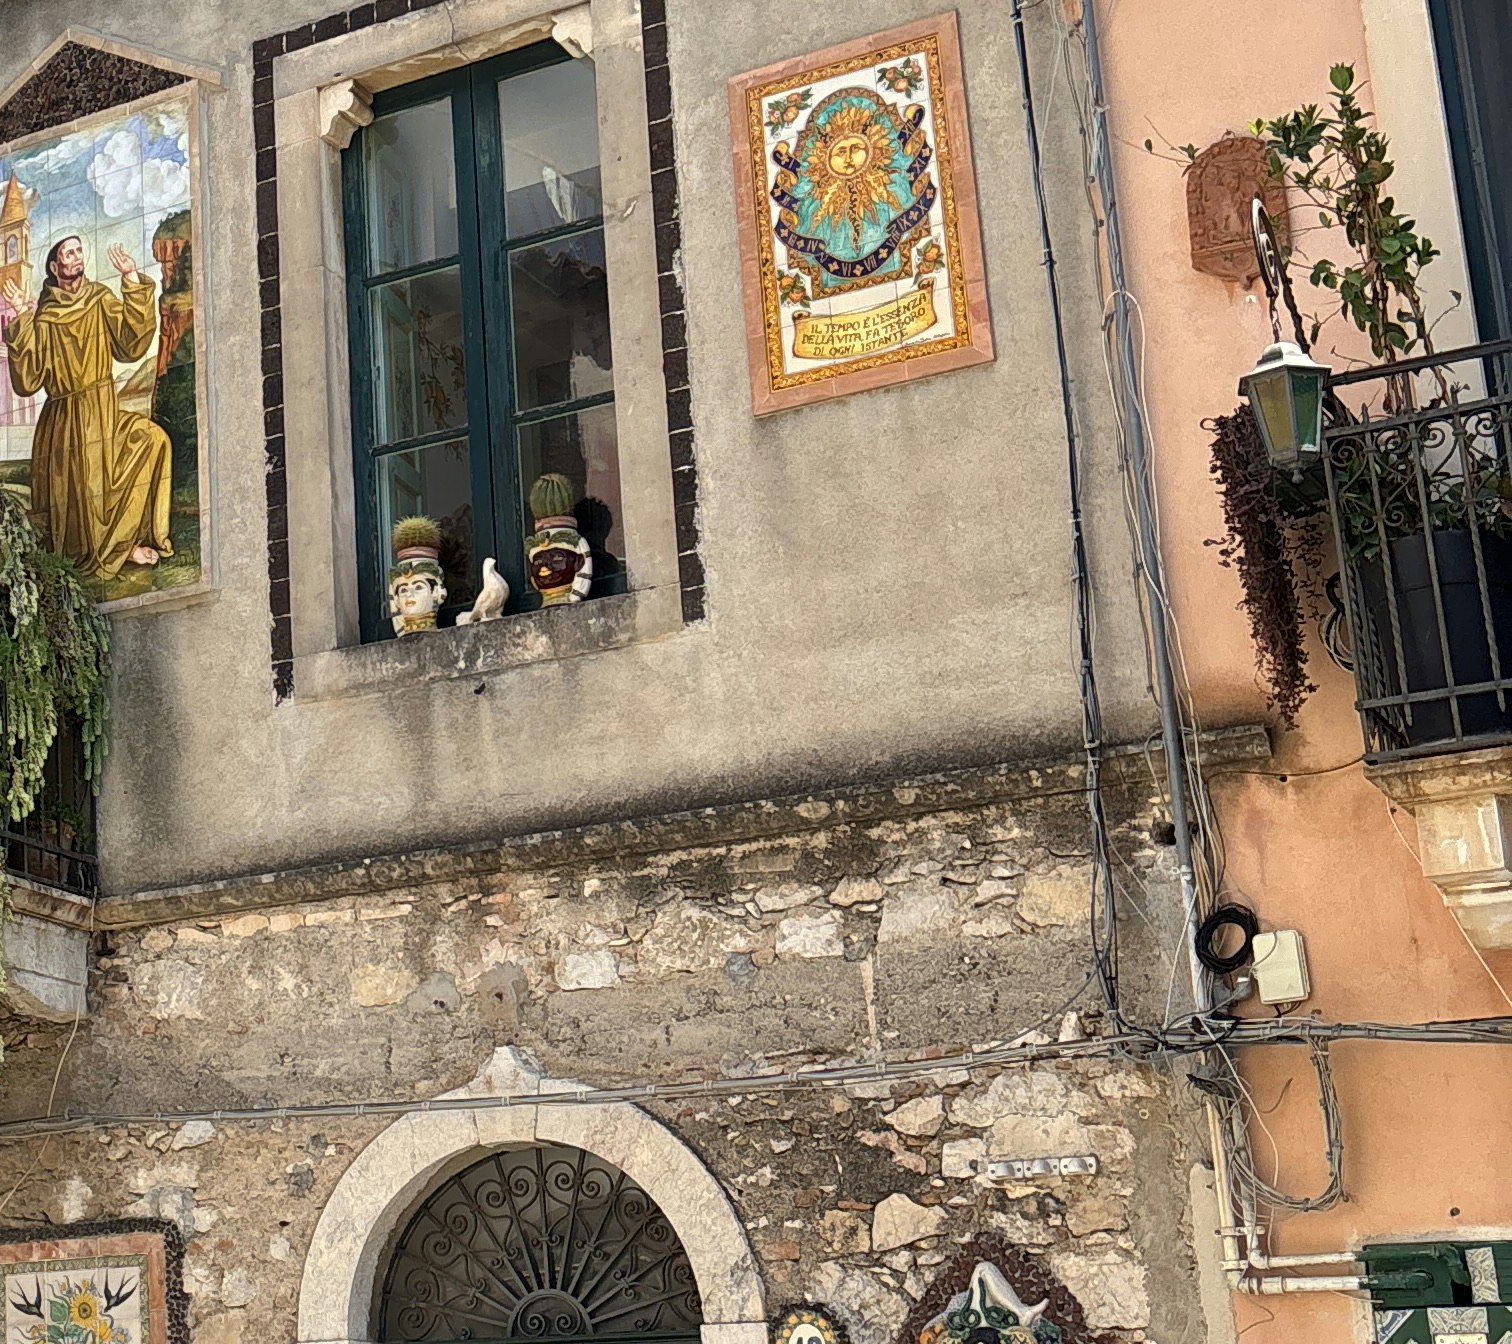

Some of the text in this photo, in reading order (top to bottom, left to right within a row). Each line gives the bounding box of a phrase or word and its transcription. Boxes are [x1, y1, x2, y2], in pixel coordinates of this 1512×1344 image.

[919, 199, 928, 215] X
[811, 323, 822, 334] IL
[824, 321, 860, 334] TEMPO
[872, 293, 926, 326] L'ESSENZA
[801, 333, 834, 345] DELLA
[836, 333, 863, 344] VITA
[866, 328, 880, 340] FA
[813, 346, 825, 356] DI
[829, 343, 855, 356] OGNI
